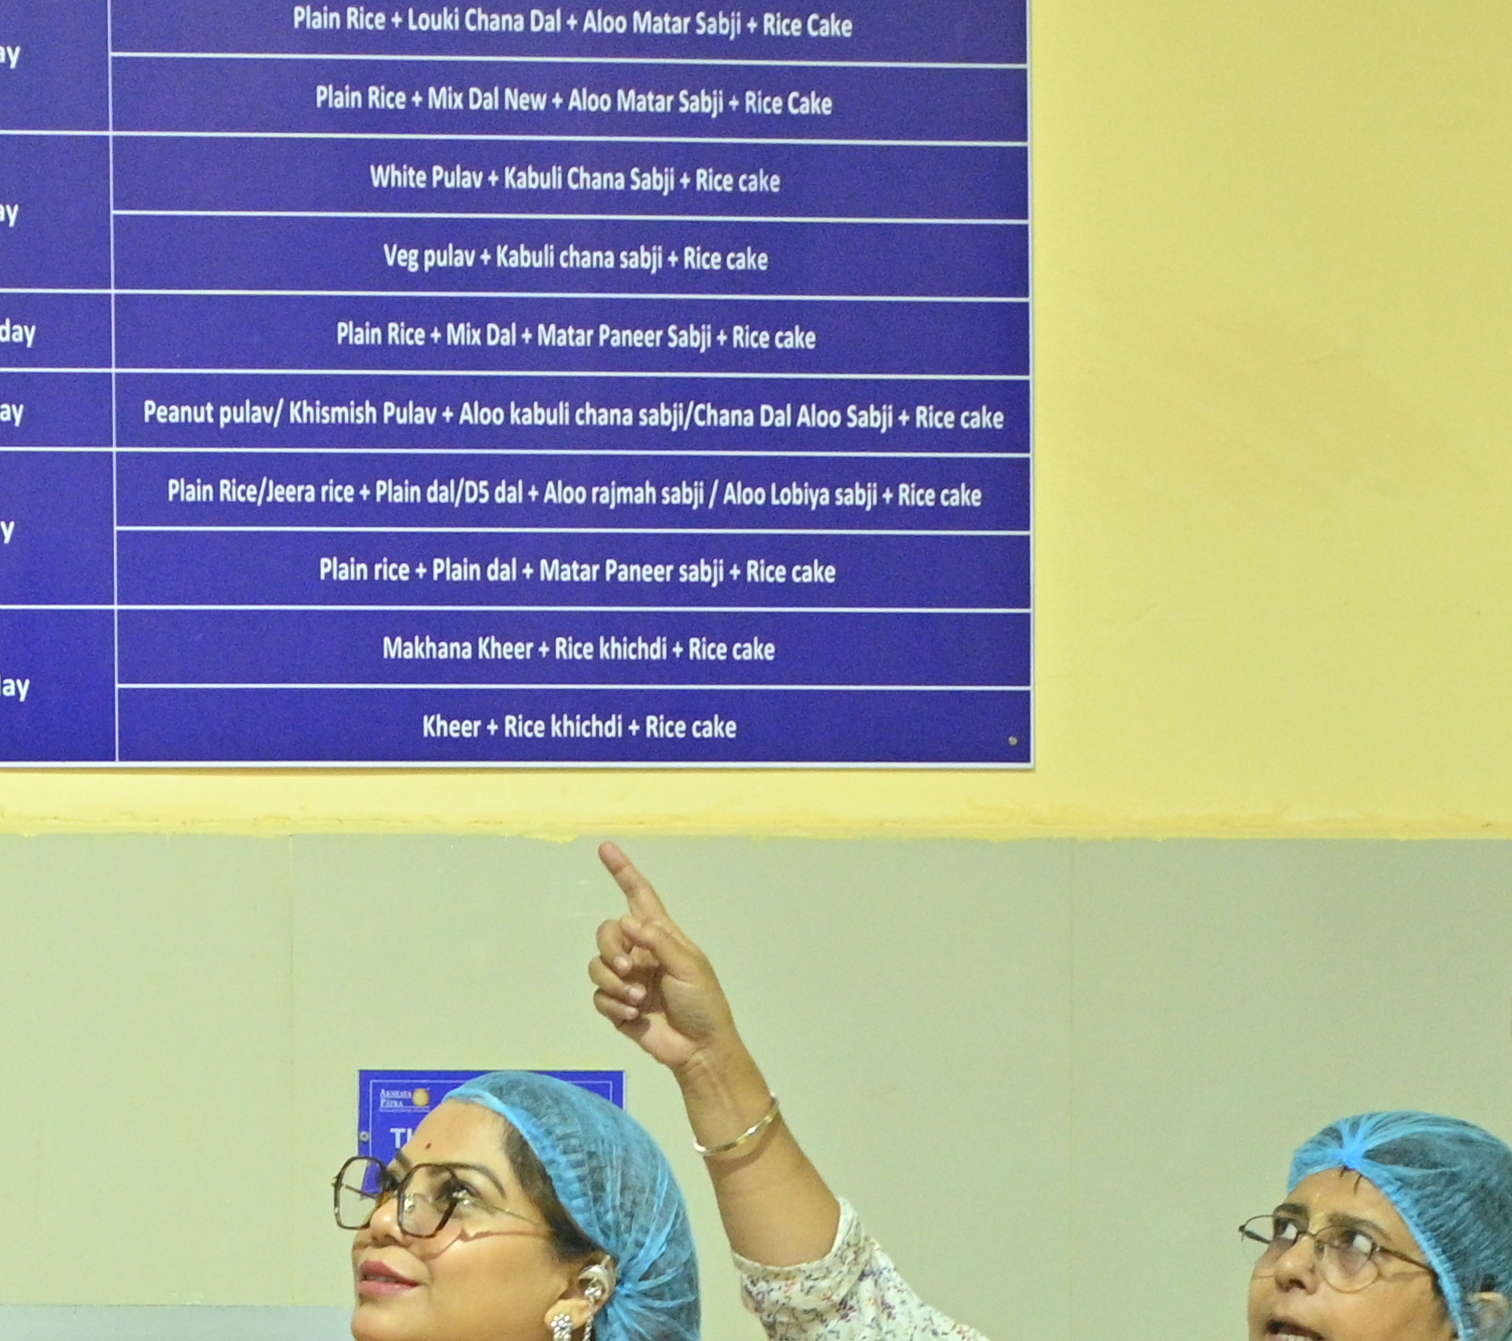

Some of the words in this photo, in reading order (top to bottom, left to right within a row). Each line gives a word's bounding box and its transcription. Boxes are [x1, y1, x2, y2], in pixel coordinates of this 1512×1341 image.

[293, 4, 341, 30] Plain
[346, 5, 387, 31] Rice
[390, 11, 403, 29] +
[407, 6, 460, 32] Louki
[464, 6, 525, 33] Chana
[529, 8, 562, 33] Dal
[566, 13, 579, 31] +
[582, 8, 628, 34] Aloo
[632, 9, 692, 35] Matar
[695, 11, 742, 41] Sabji
[746, 16, 758, 33] +
[763, 11, 803, 38] Rice
[806, 12, 853, 38] Cake
[383, 243, 420, 273] Veg
[423, 242, 476, 273] pulav
[479, 248, 492, 265] +
[496, 242, 555, 269] Kabuli
[559, 243, 615, 269] chana
[619, 244, 663, 275] sabji
[667, 250, 679, 268] +
[683, 245, 722, 271] Rice
[726, 246, 769, 271] cake
[143, 399, 215, 424] Peanut
[219, 396, 285, 430] pulav/
[289, 399, 378, 426] Khismish
[383, 400, 438, 425] Pulav
[441, 405, 454, 423] +
[458, 400, 505, 426] Aloo
[509, 401, 570, 426] kabuli
[574, 401, 634, 426] chana
[638, 399, 755, 432] sabji/Chana
[760, 402, 792, 428] Dal
[796, 403, 842, 429] Aloo
[846, 403, 894, 434] Sabji
[898, 409, 910, 426] +
[915, 404, 956, 430] Rice
[960, 405, 1005, 430] cake
[167, 477, 214, 503] Plain
[219, 475, 316, 507] Rice/Jeera
[320, 478, 355, 503] rice
[359, 483, 371, 502] +
[375, 478, 422, 504] Plain
[494, 478, 524, 505] dal
[527, 484, 540, 502] +
[543, 479, 587, 505] Aloo
[591, 479, 657, 511] rajmah
[661, 480, 705, 511] sabji
[708, 479, 719, 510] /
[722, 480, 767, 506] Aloo
[770, 480, 830, 511] Lobiya
[834, 481, 878, 512] sabji
[882, 487, 894, 504] +
[898, 482, 936, 508] Rice
[940, 482, 982, 507] cake
[422, 713, 482, 738] Kheer
[486, 718, 499, 736] +
[504, 713, 546, 739] Rice
[550, 713, 623, 738] khichdi
[627, 719, 641, 736] +
[645, 713, 687, 739] Rice
[691, 713, 738, 739] cake
